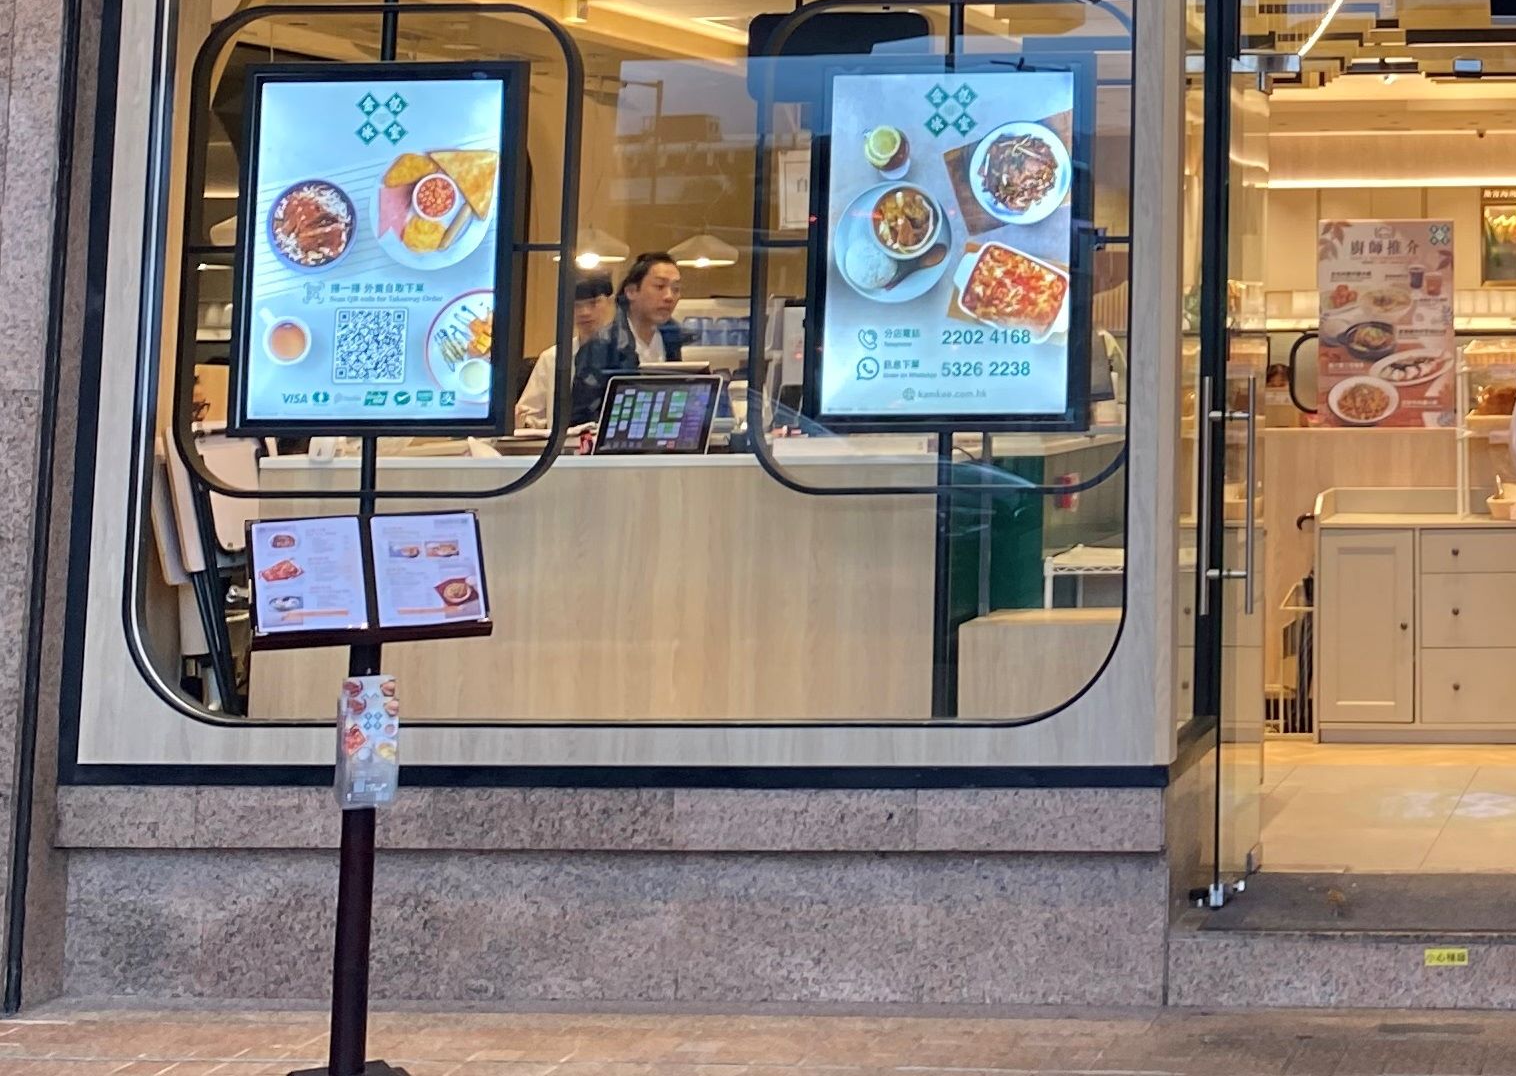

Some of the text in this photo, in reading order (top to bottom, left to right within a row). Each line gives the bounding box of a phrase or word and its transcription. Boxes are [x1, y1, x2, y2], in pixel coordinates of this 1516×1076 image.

[941, 329, 1031, 345] 2202 4168
[941, 361, 1031, 377] 5326 2238
[282, 393, 308, 404] VISA
